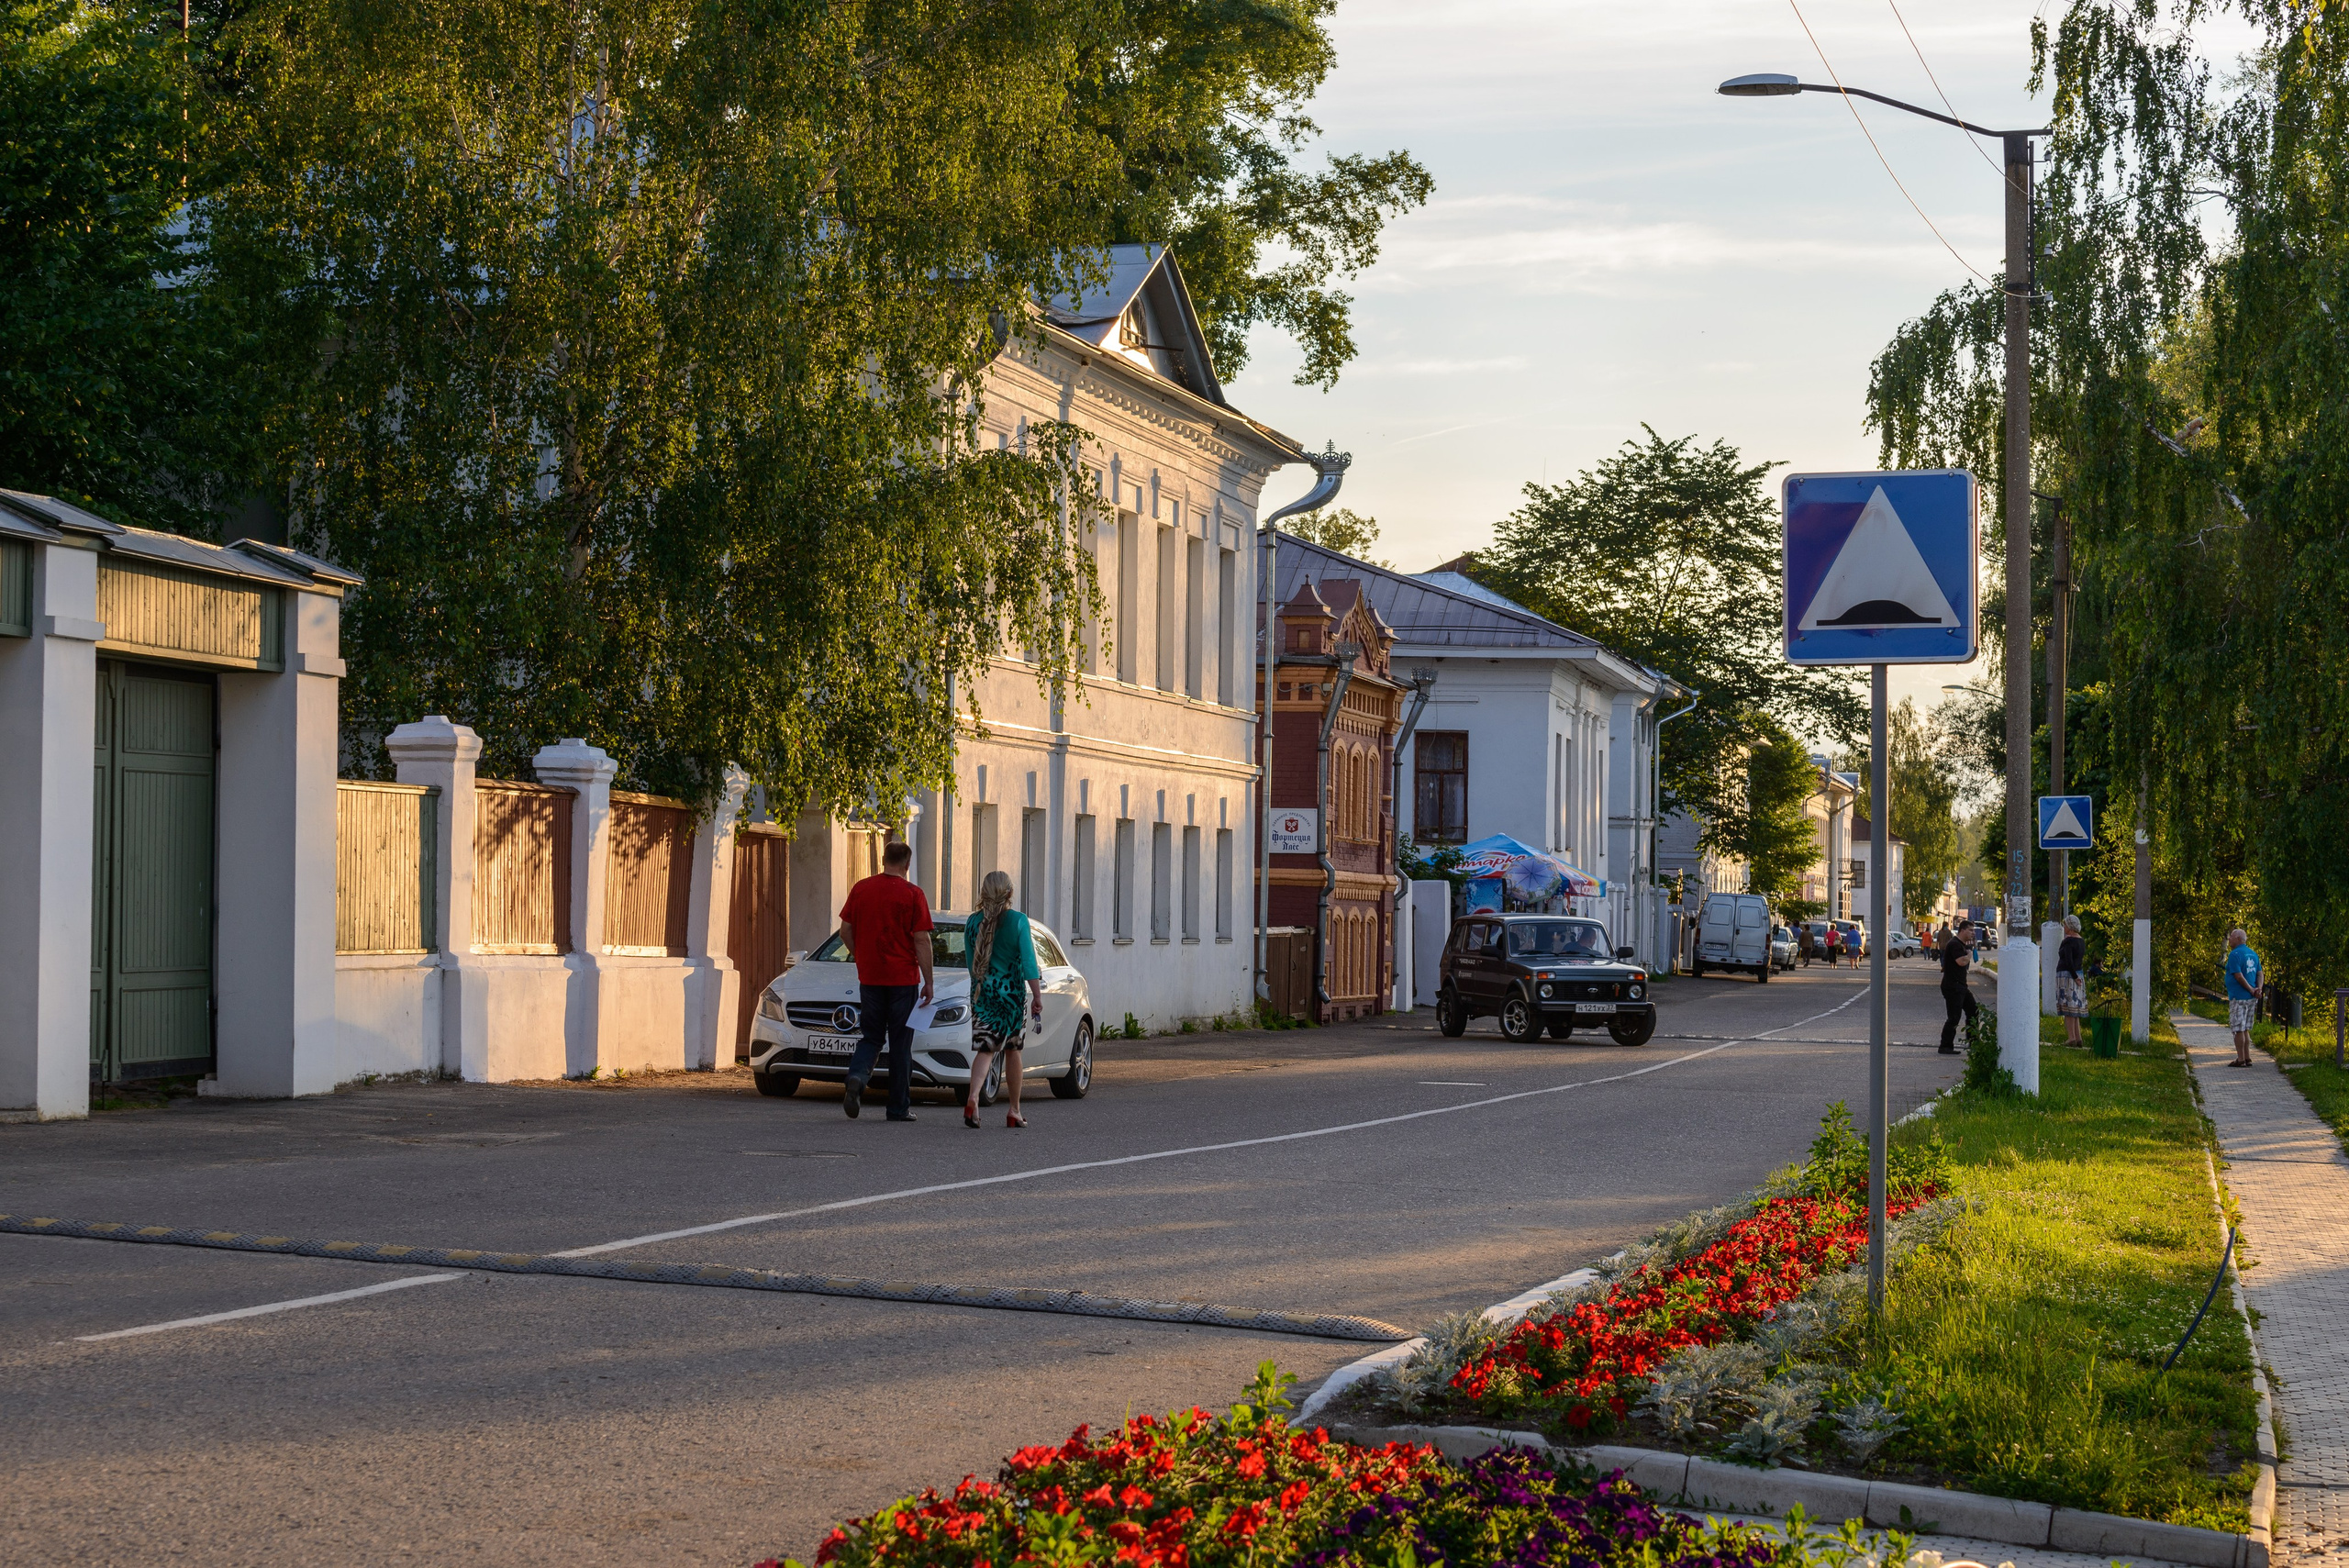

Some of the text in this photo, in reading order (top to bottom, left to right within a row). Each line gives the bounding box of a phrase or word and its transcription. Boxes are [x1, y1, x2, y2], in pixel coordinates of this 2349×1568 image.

[1272, 829, 1311, 845] Фортеция
[2012, 850, 2024, 863] 15
[2014, 865, 2021, 880] 3
[812, 1038, 855, 1051] У841КМ
